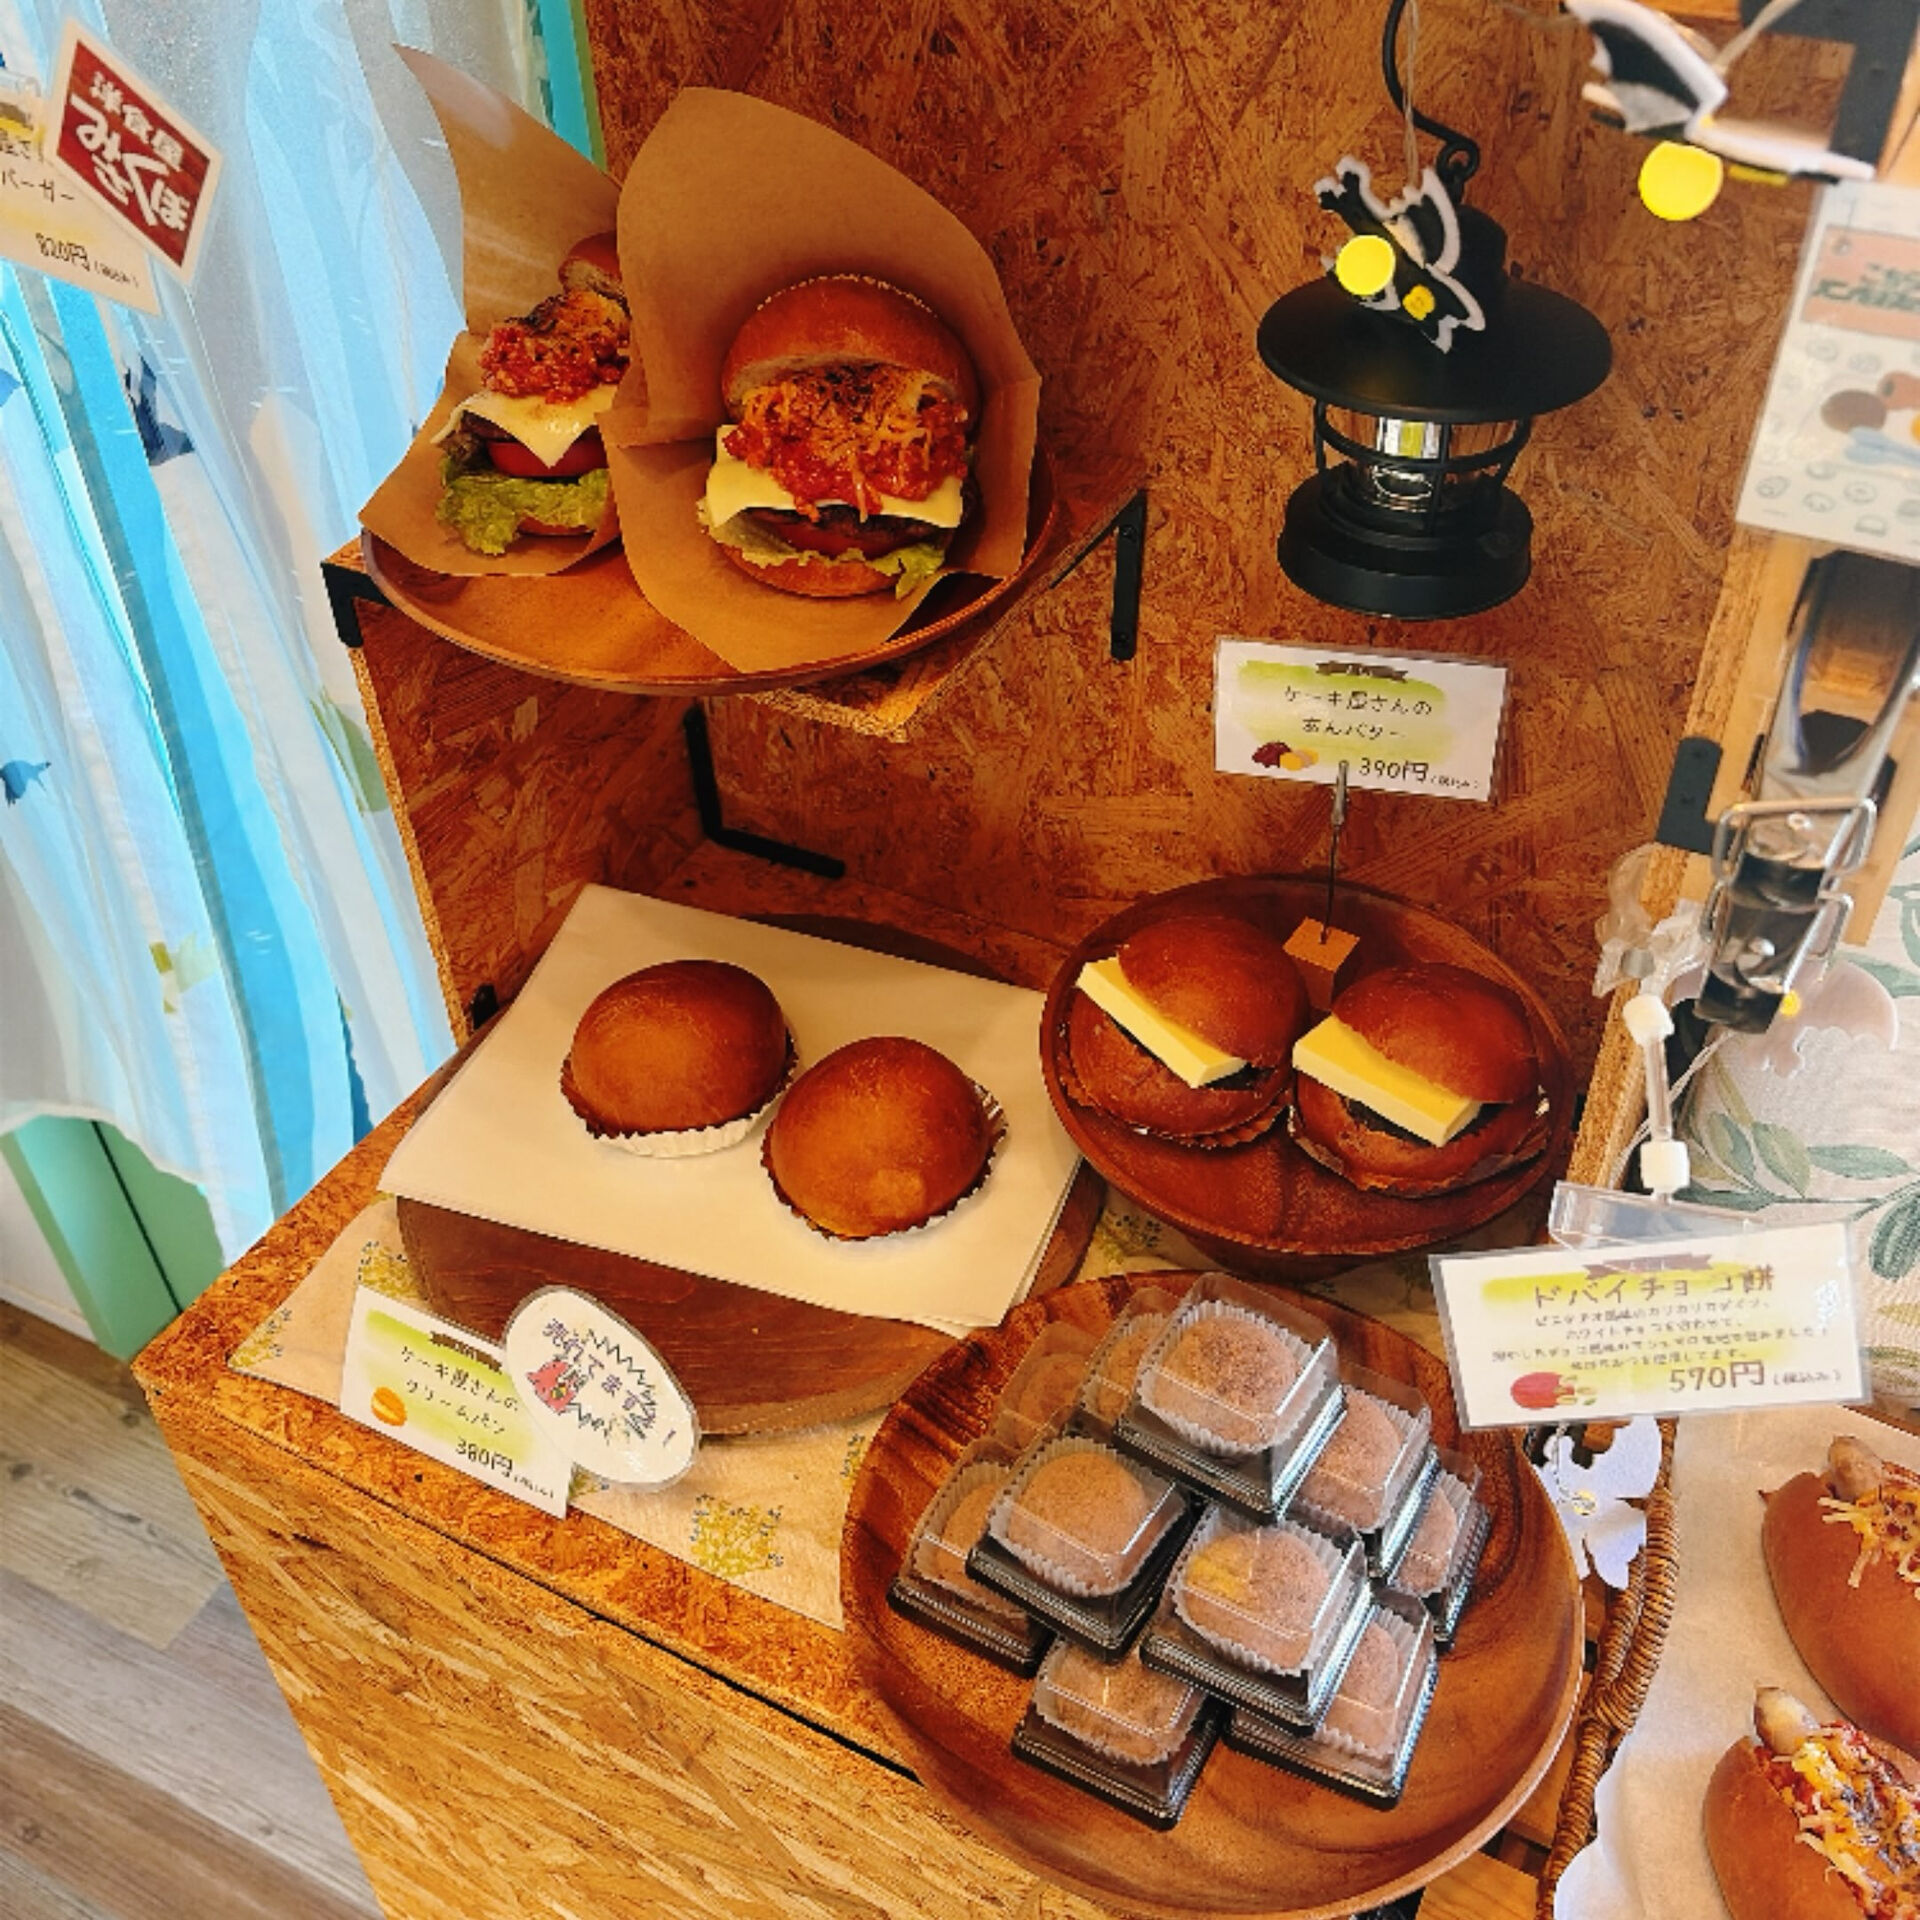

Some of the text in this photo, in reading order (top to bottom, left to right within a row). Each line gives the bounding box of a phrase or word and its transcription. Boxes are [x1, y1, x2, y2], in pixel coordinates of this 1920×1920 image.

[90, 71, 185, 172] 洋食屋
[1284, 685, 1433, 715] ケーキ屋さんの
[1302, 716, 1406, 741] あんバター
[1358, 756, 1429, 783] 390円
[1534, 1263, 1776, 1309] ドバイチョコ餅
[400, 1345, 519, 1412] ケーキ屋さんの
[406, 1379, 505, 1435] クリームパン
[456, 1436, 513, 1478] 380円
